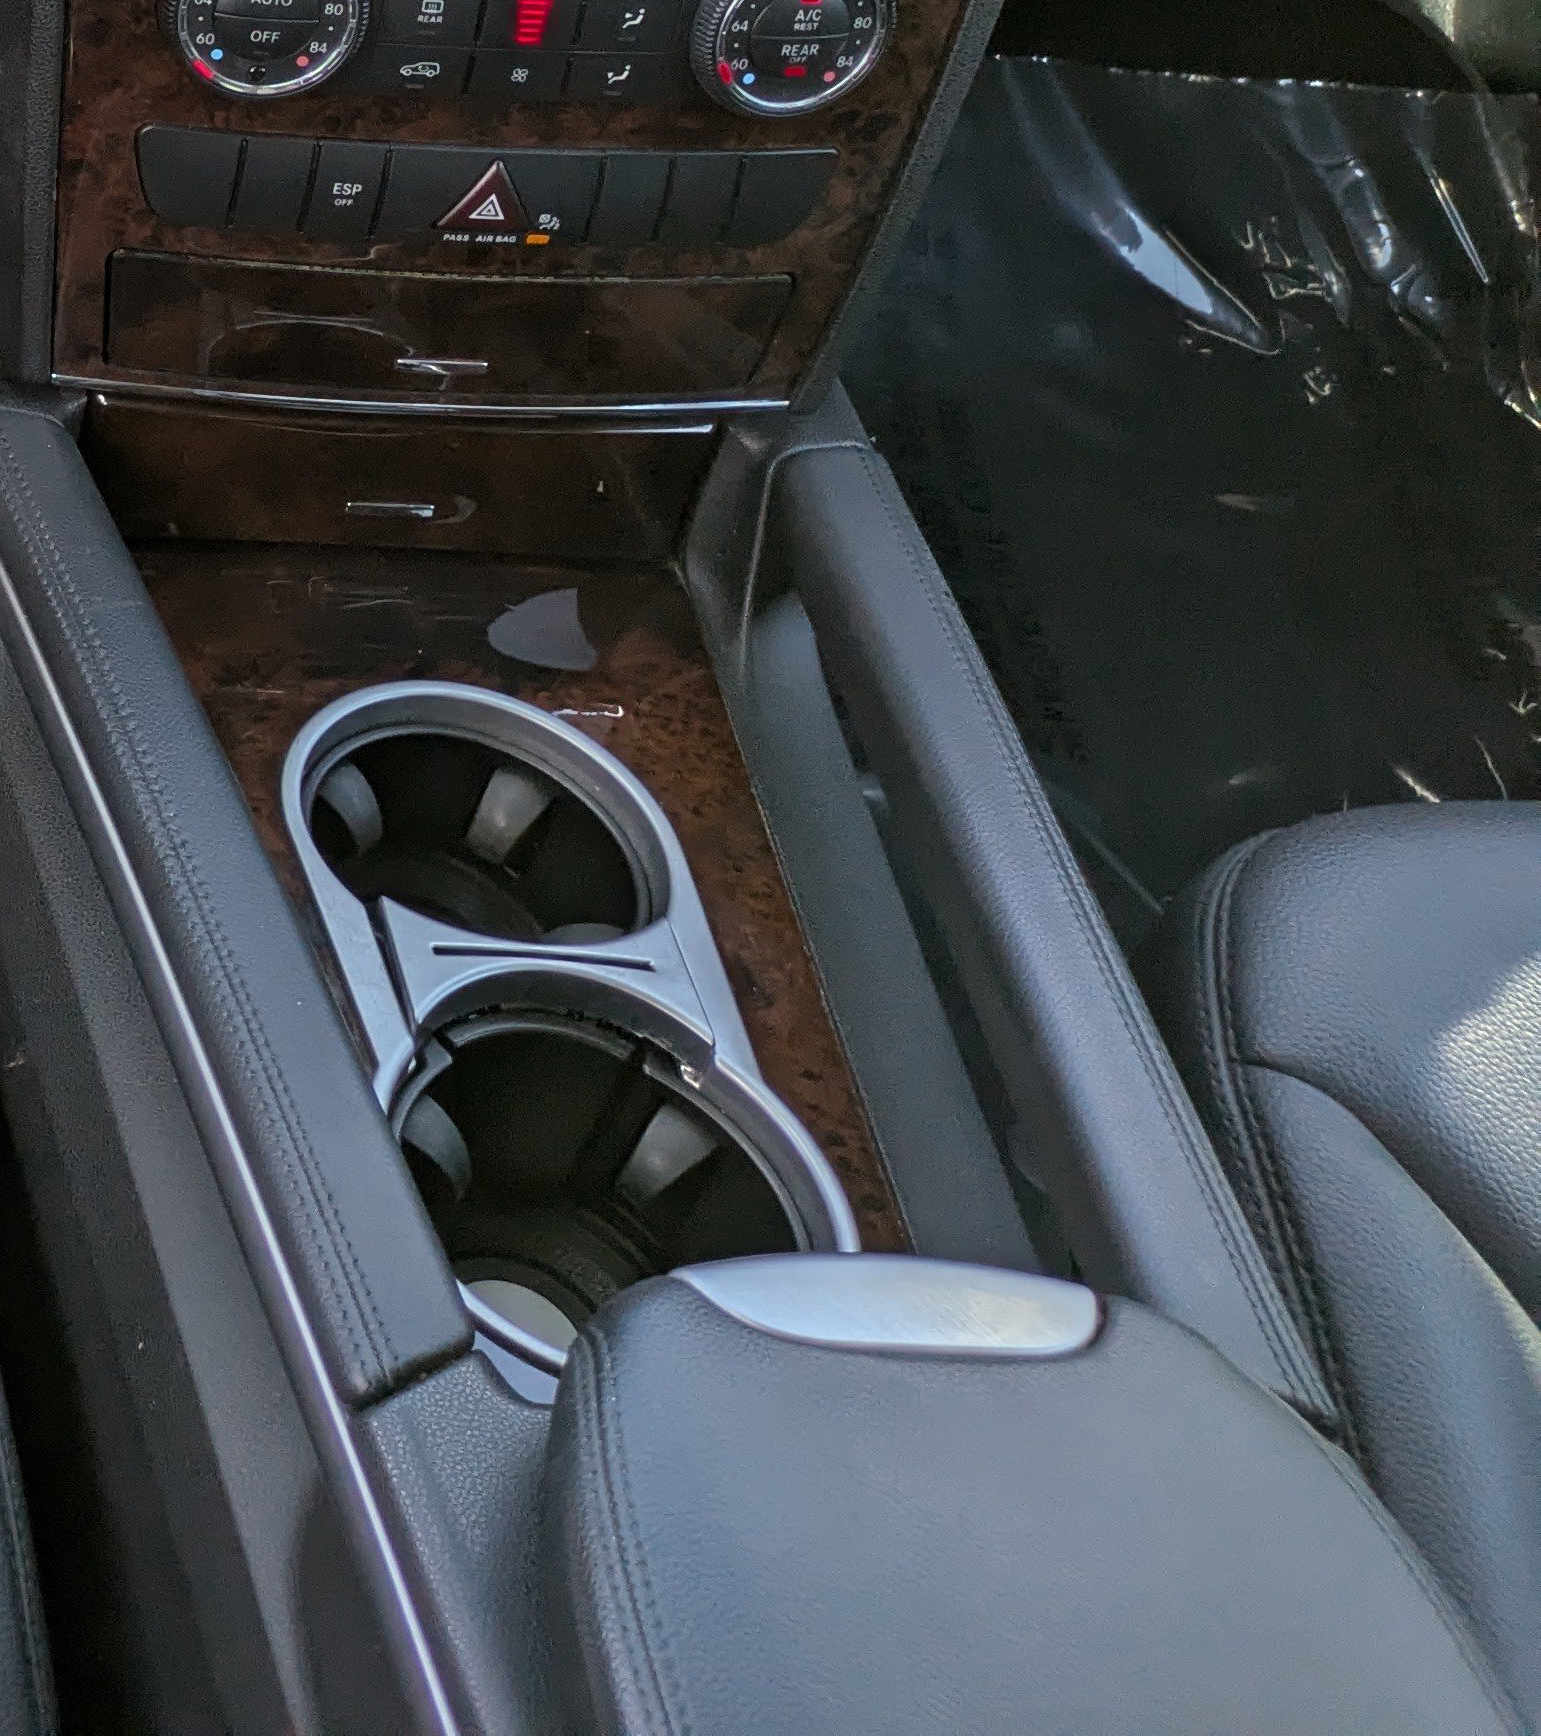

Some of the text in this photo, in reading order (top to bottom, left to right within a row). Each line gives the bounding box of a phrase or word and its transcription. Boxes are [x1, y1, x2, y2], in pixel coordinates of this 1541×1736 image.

[324, 3, 344, 16] 80
[794, 9, 822, 22] A/C
[417, 15, 443, 24] REAR
[853, 16, 872, 29] 80
[731, 20, 749, 32] 64
[793, 23, 818, 31] REST
[195, 33, 215, 45] 60
[250, 30, 281, 44] OFF
[309, 42, 328, 53] 84
[781, 44, 820, 57] REAR
[730, 58, 749, 70] 60
[836, 56, 854, 68] 84
[332, 182, 363, 196] ESP
[334, 198, 354, 207] OFF
[443, 233, 470, 242] PASS
[475, 234, 494, 243] AIR
[495, 234, 517, 243] BAG
